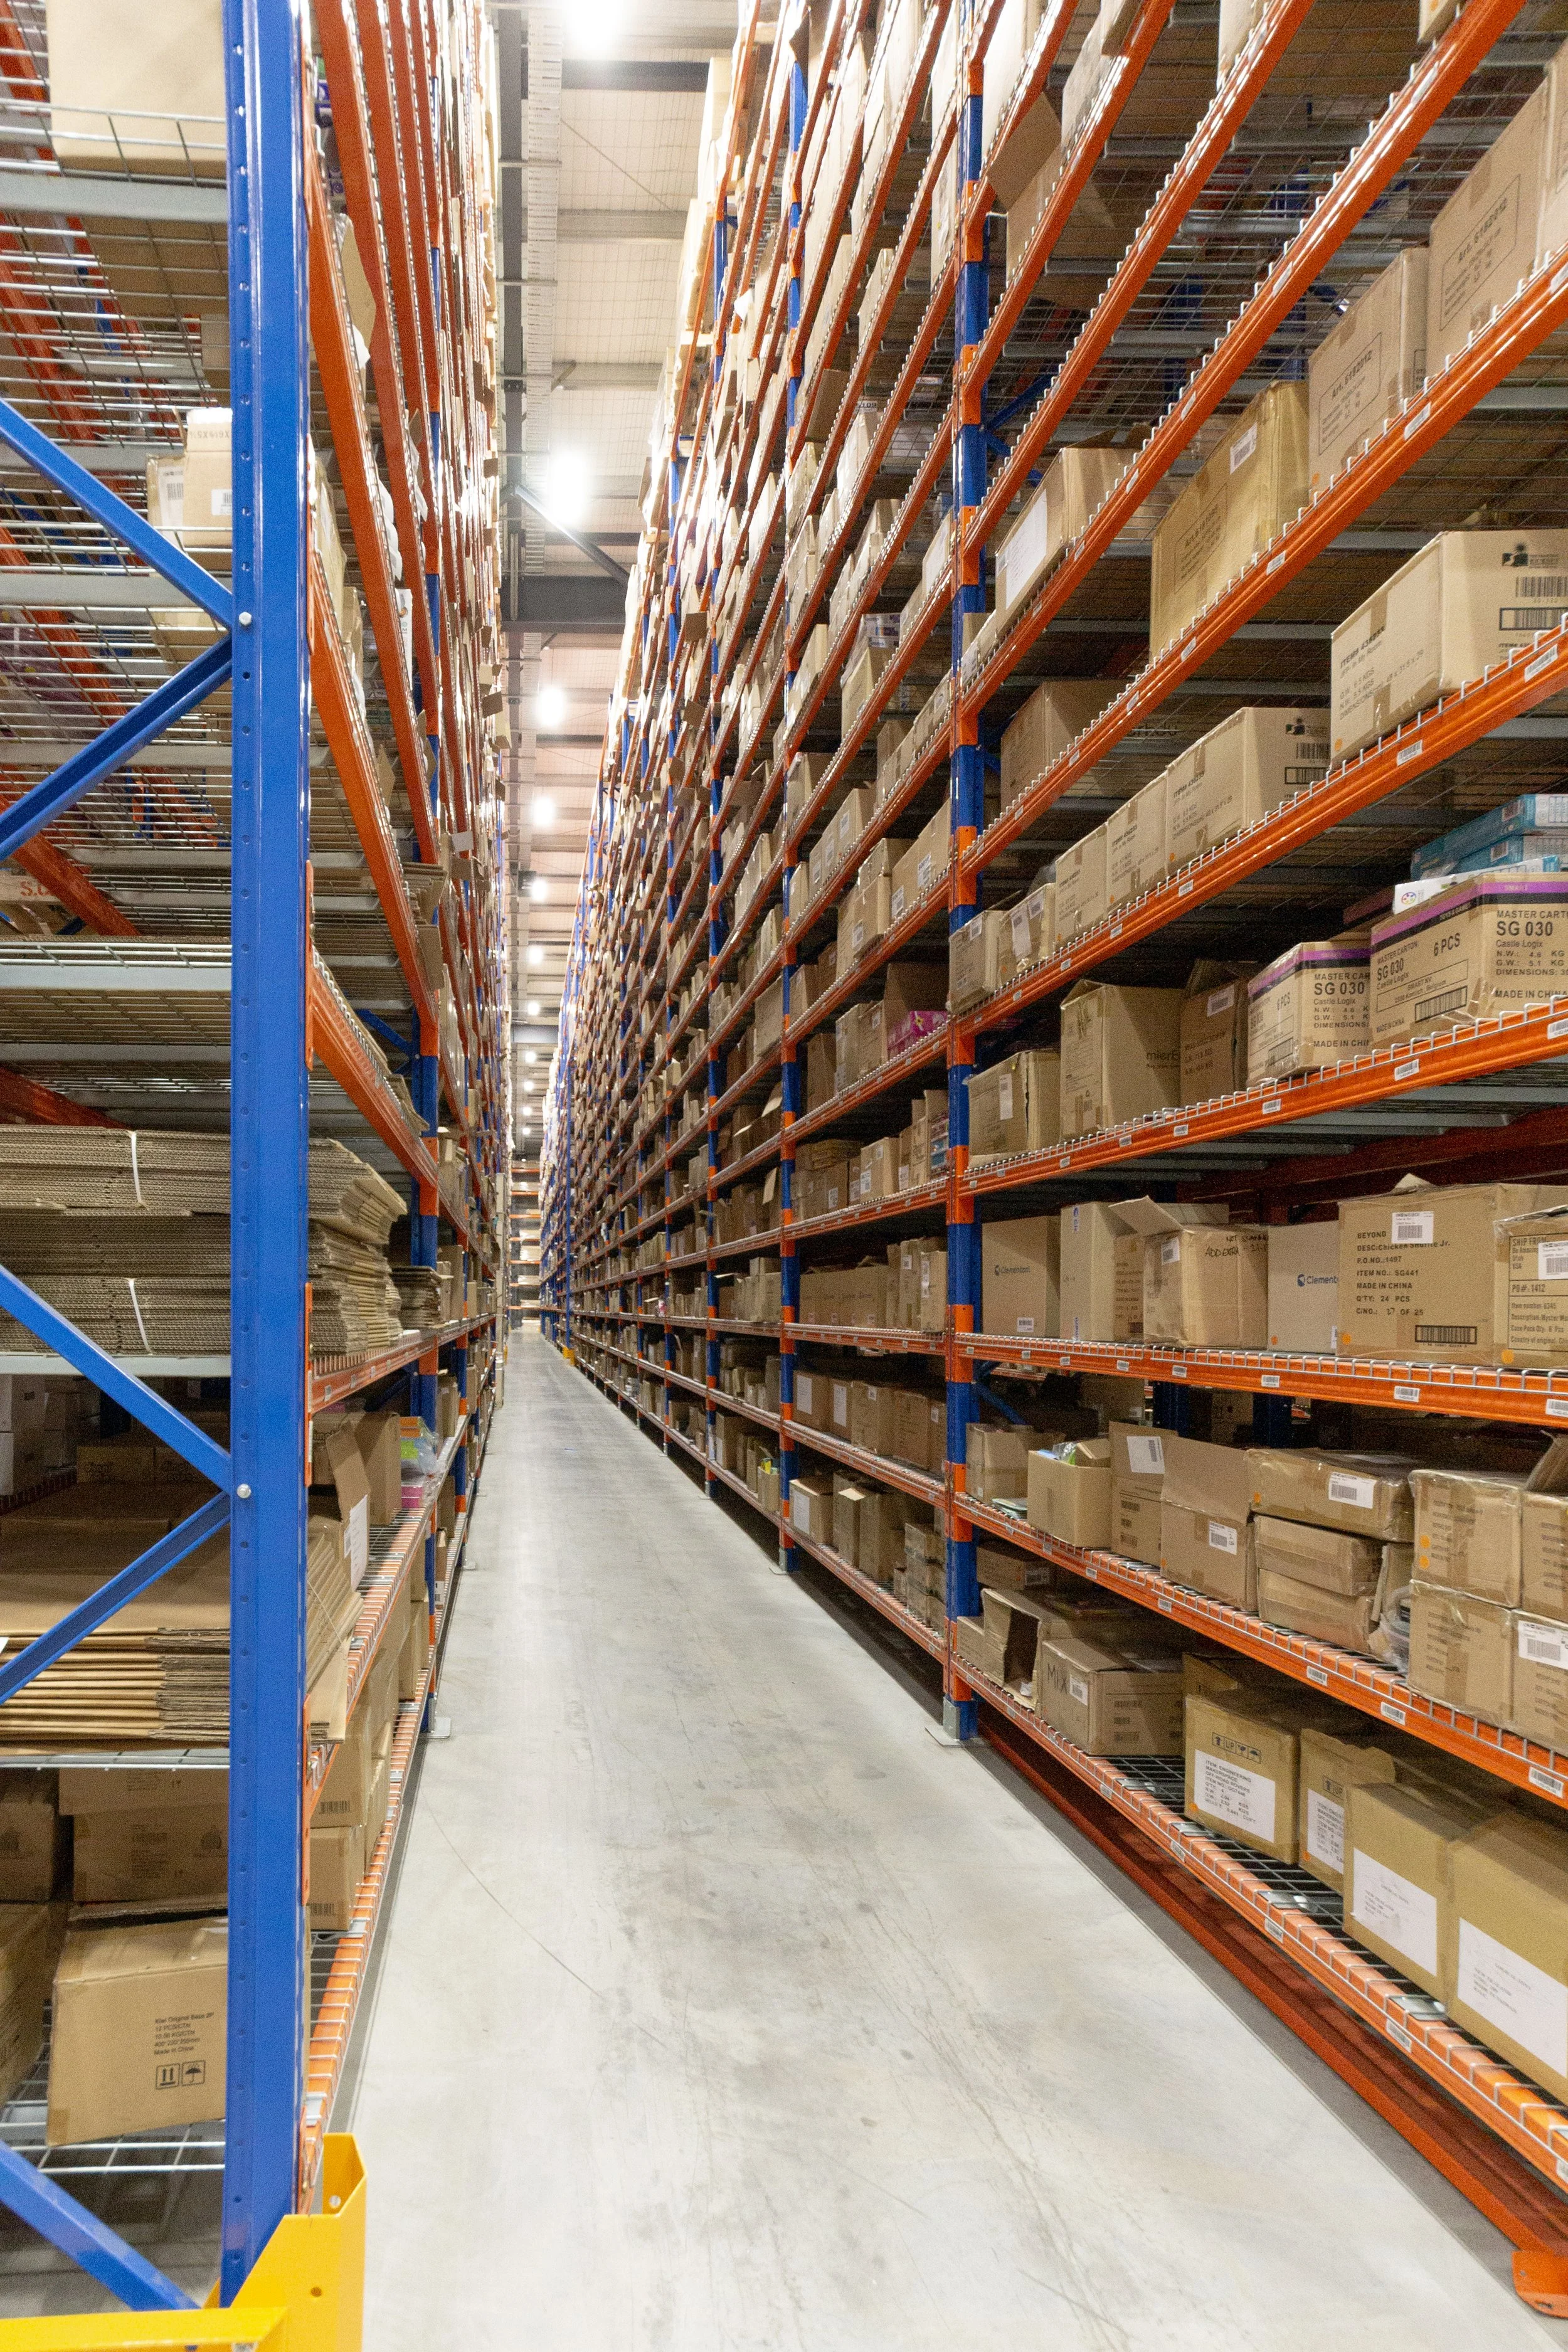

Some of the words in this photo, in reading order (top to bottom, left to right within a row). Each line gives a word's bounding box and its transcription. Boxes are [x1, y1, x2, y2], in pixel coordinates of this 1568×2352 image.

[1496, 910, 1537, 918] MASTER
[1496, 921, 1520, 936] SG
[1525, 921, 1553, 936] 030
[1433, 942, 1439, 956] 6
[1441, 933, 1460, 953] PCS
[1496, 940, 1519, 948] Castle
[1522, 940, 1543, 949] Logix
[1377, 950, 1397, 964] MASTER
[1377, 965, 1389, 981] SG
[1391, 958, 1404, 975] 030
[1314, 982, 1335, 995] SG
[1340, 982, 1364, 995] 030
[1495, 990, 1523, 999] MADE
[1357, 1231, 1387, 1239] BEYOND
[1512, 1237, 1527, 1247] SHIP
[1205, 1246, 1222, 1258] ADD
[1511, 1336, 1530, 1344] Country
[1225, 1741, 1235, 1750] UP
[1205, 1766, 1238, 1783] MAKERSPACE
[1219, 1764, 1252, 1783] ENGINEERING
